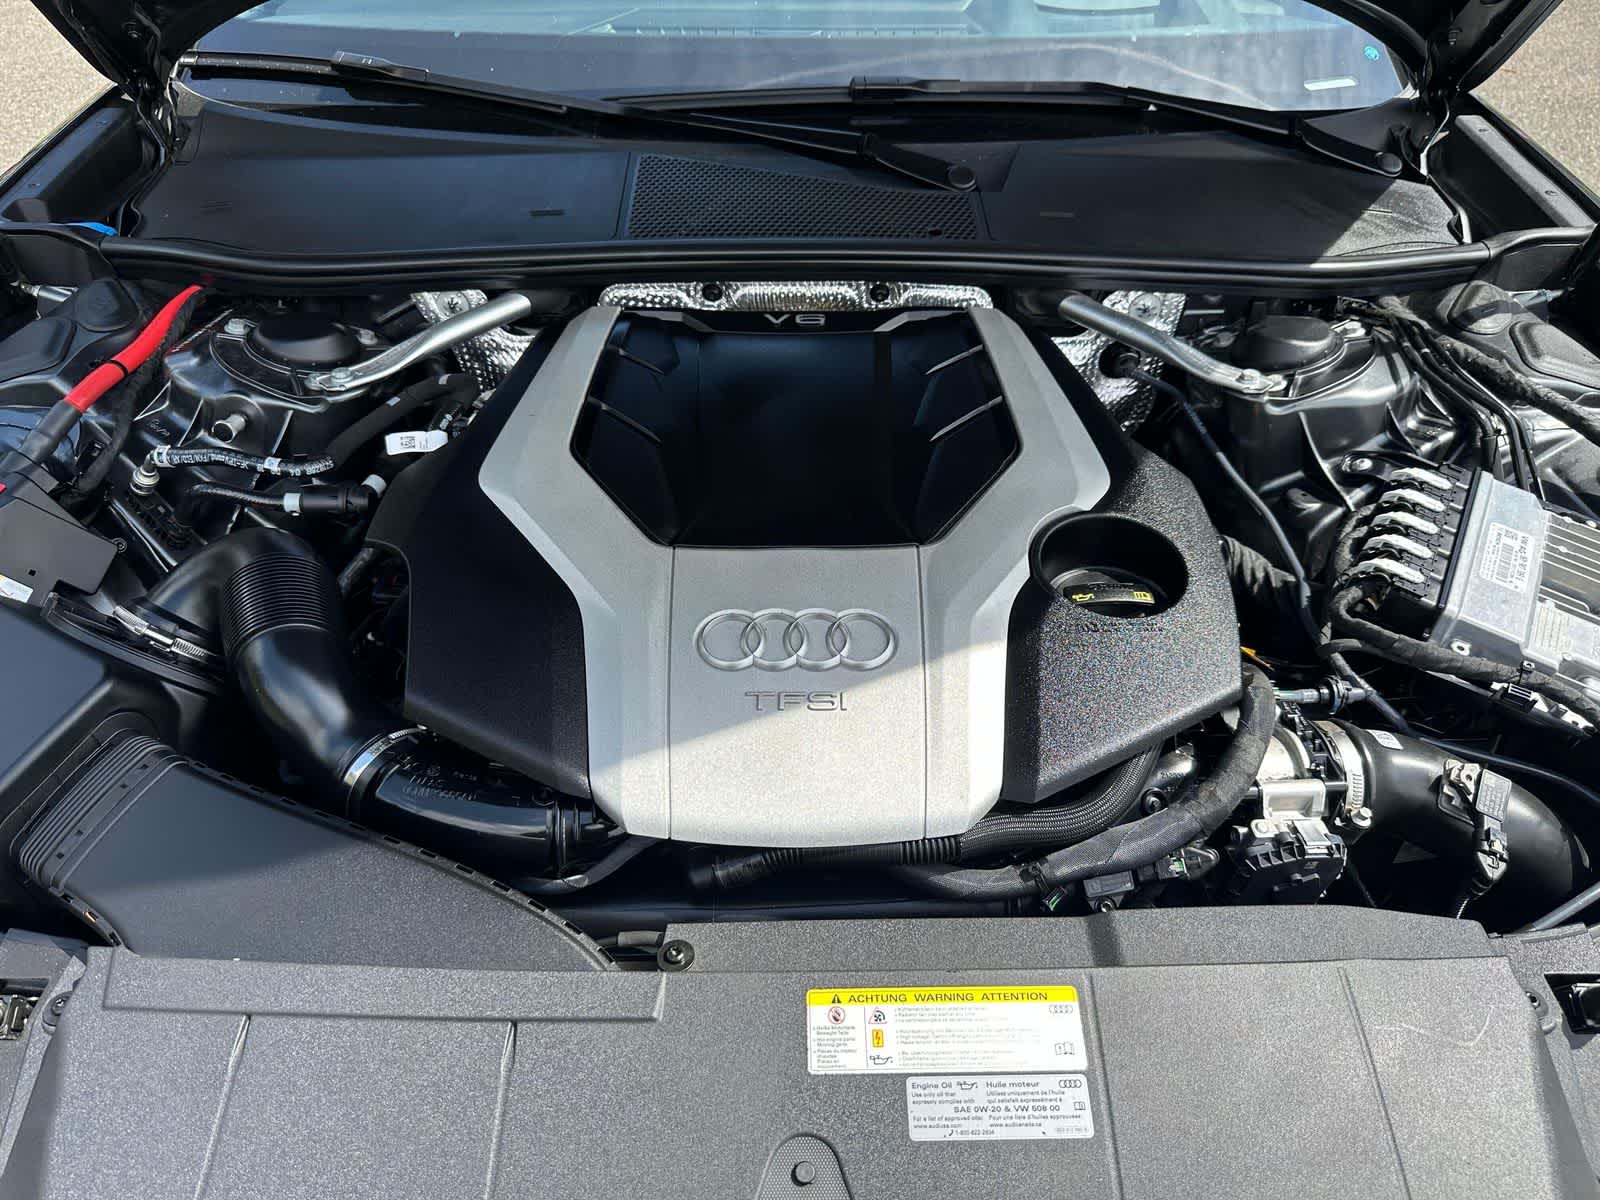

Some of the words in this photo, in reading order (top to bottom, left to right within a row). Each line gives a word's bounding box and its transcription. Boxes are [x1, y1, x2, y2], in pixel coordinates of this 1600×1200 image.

[763, 313, 826, 327] V6
[744, 690, 848, 712] TFSI
[848, 993, 907, 1003] ACHTUNG
[914, 993, 975, 1002] WARNING
[981, 991, 1048, 1001] ATTENTION
[911, 1082, 939, 1091] Engine
[941, 1081, 953, 1089] Oil
[973, 1105, 1002, 1113] 0W-20
[1031, 1104, 1048, 1112] 508
[1049, 1104, 1060, 1112] 00
